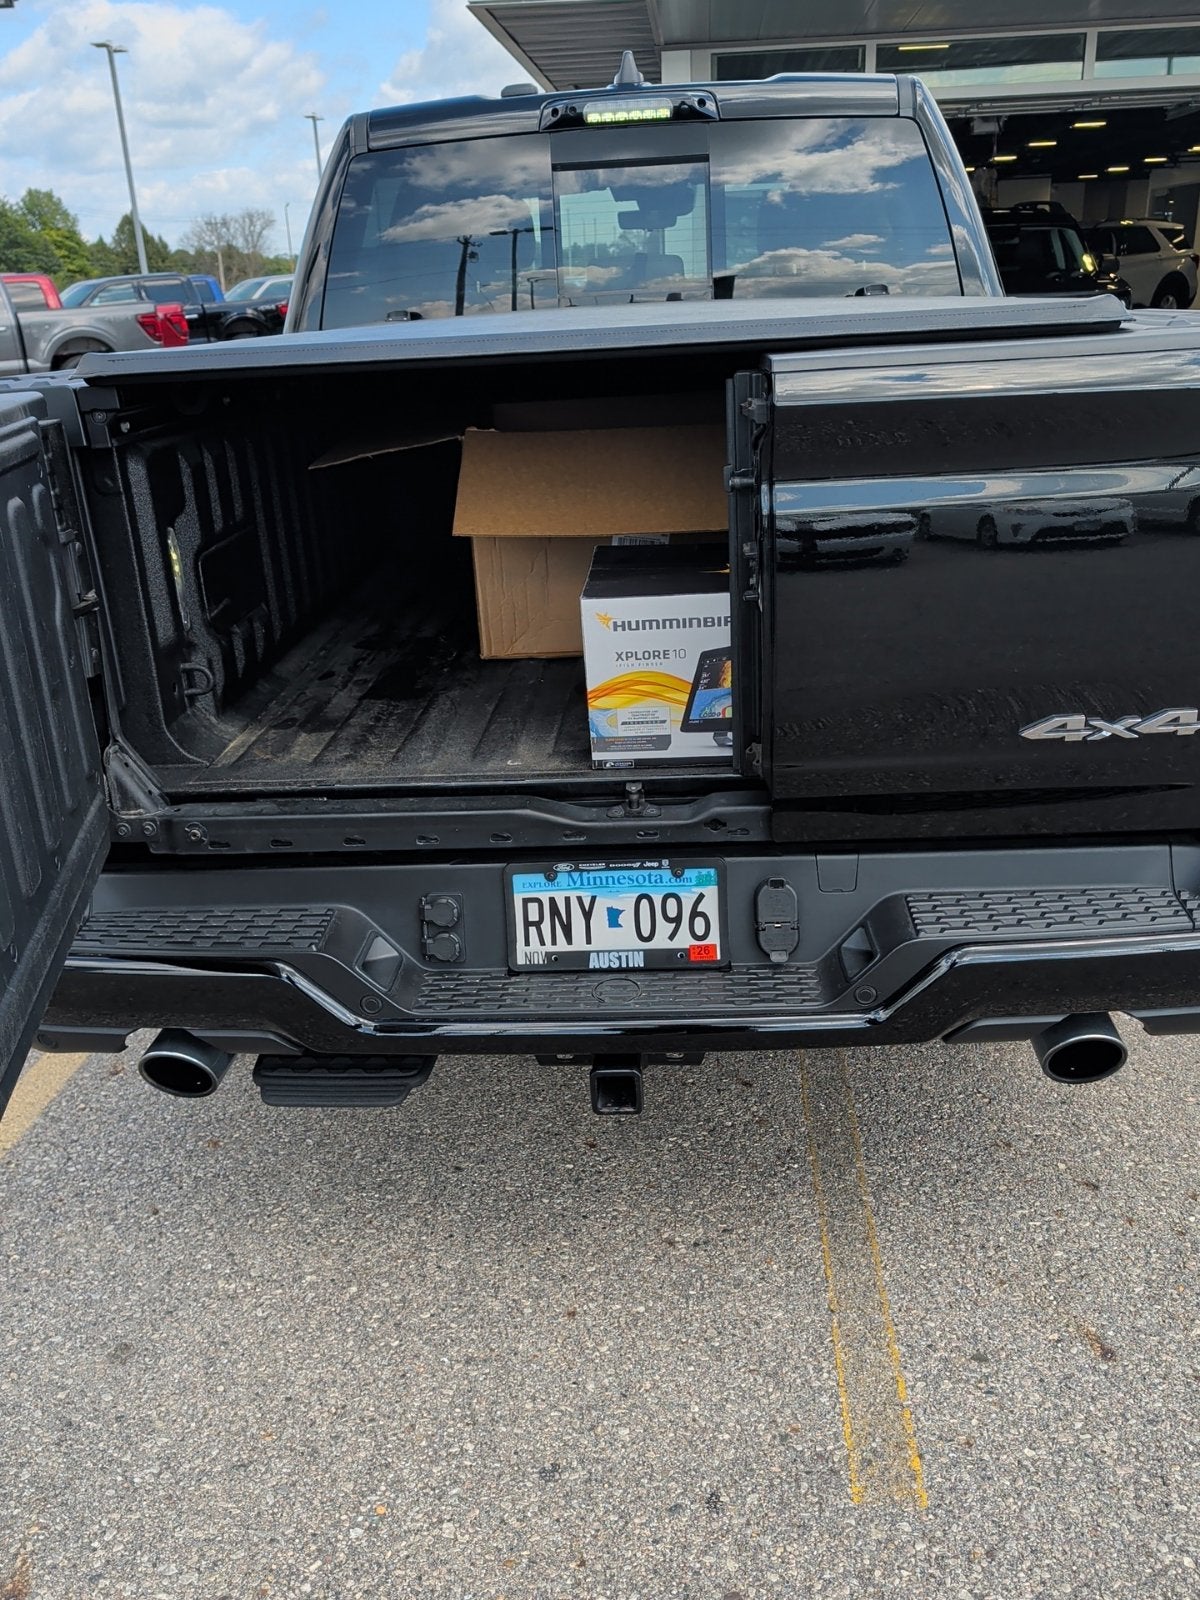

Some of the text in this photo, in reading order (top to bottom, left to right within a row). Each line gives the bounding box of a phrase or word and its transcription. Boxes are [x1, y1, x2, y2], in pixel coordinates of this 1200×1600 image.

[613, 615, 733, 632] HUMMINBIR
[522, 880, 561, 889] EXPLORE
[521, 892, 711, 947] RNY 096
[696, 945, 710, 955] 26
[588, 950, 645, 969] AUSTIN
